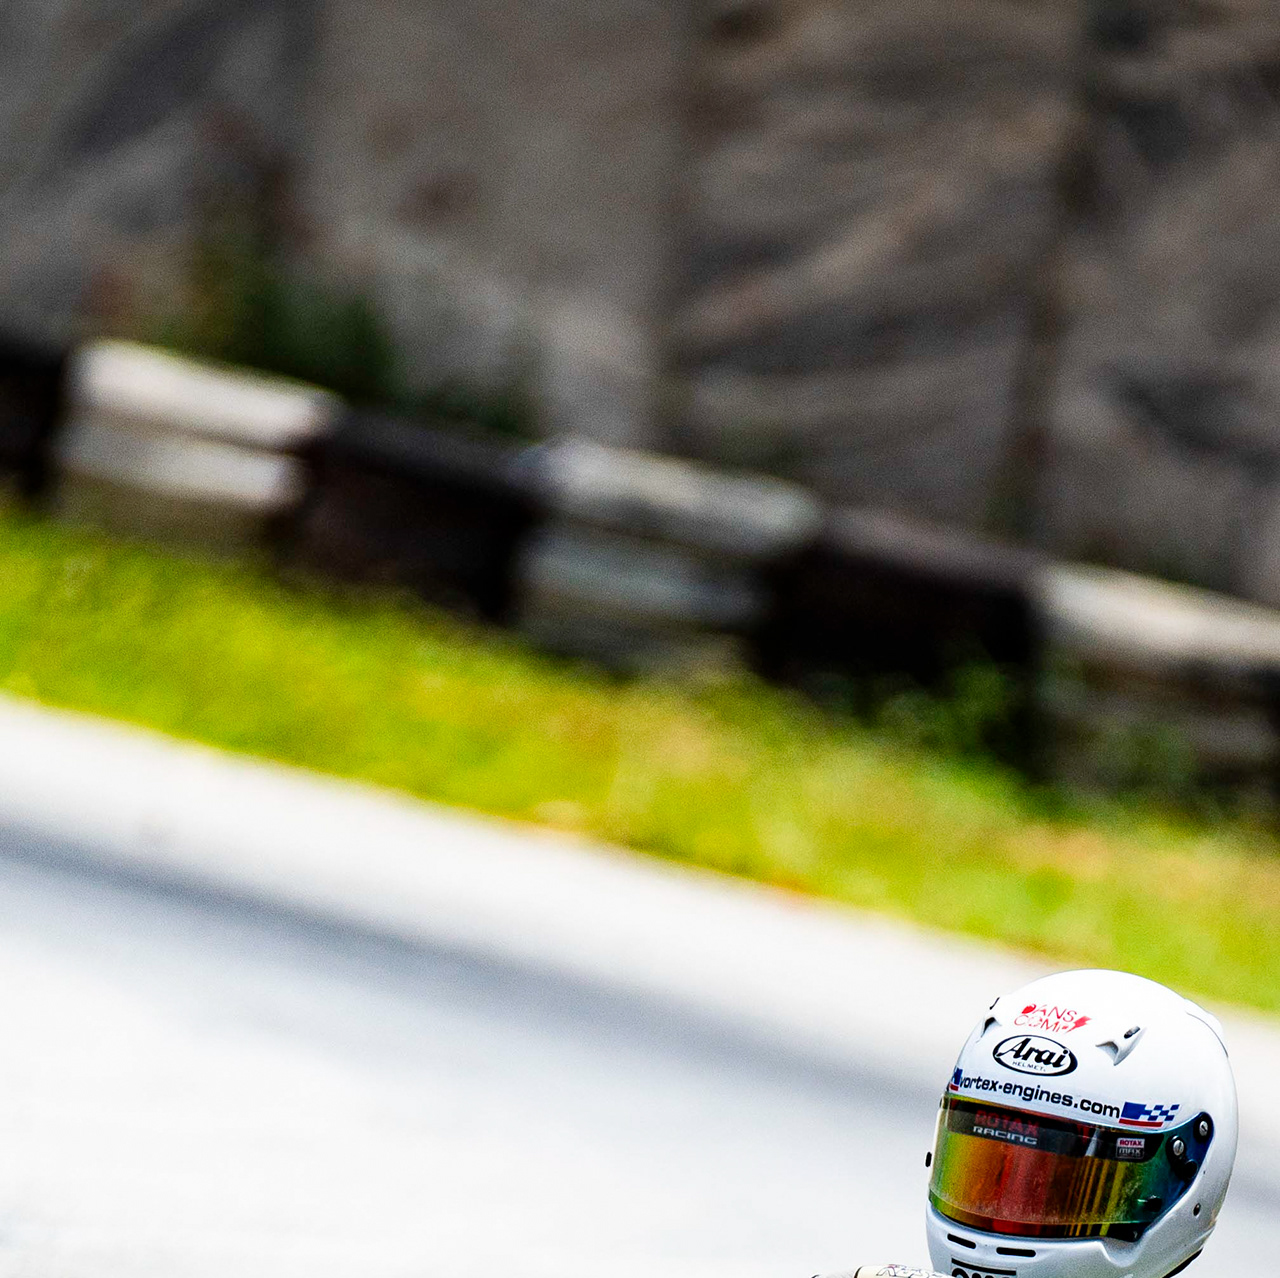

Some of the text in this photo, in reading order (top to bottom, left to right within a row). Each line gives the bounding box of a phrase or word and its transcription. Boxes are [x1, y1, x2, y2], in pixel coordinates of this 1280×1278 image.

[996, 1038, 1067, 1067] Arai
[1012, 1061, 1045, 1072] HELMET
[959, 1075, 1120, 1119] vortex-engines.com
[974, 1109, 1040, 1137] ROTAX
